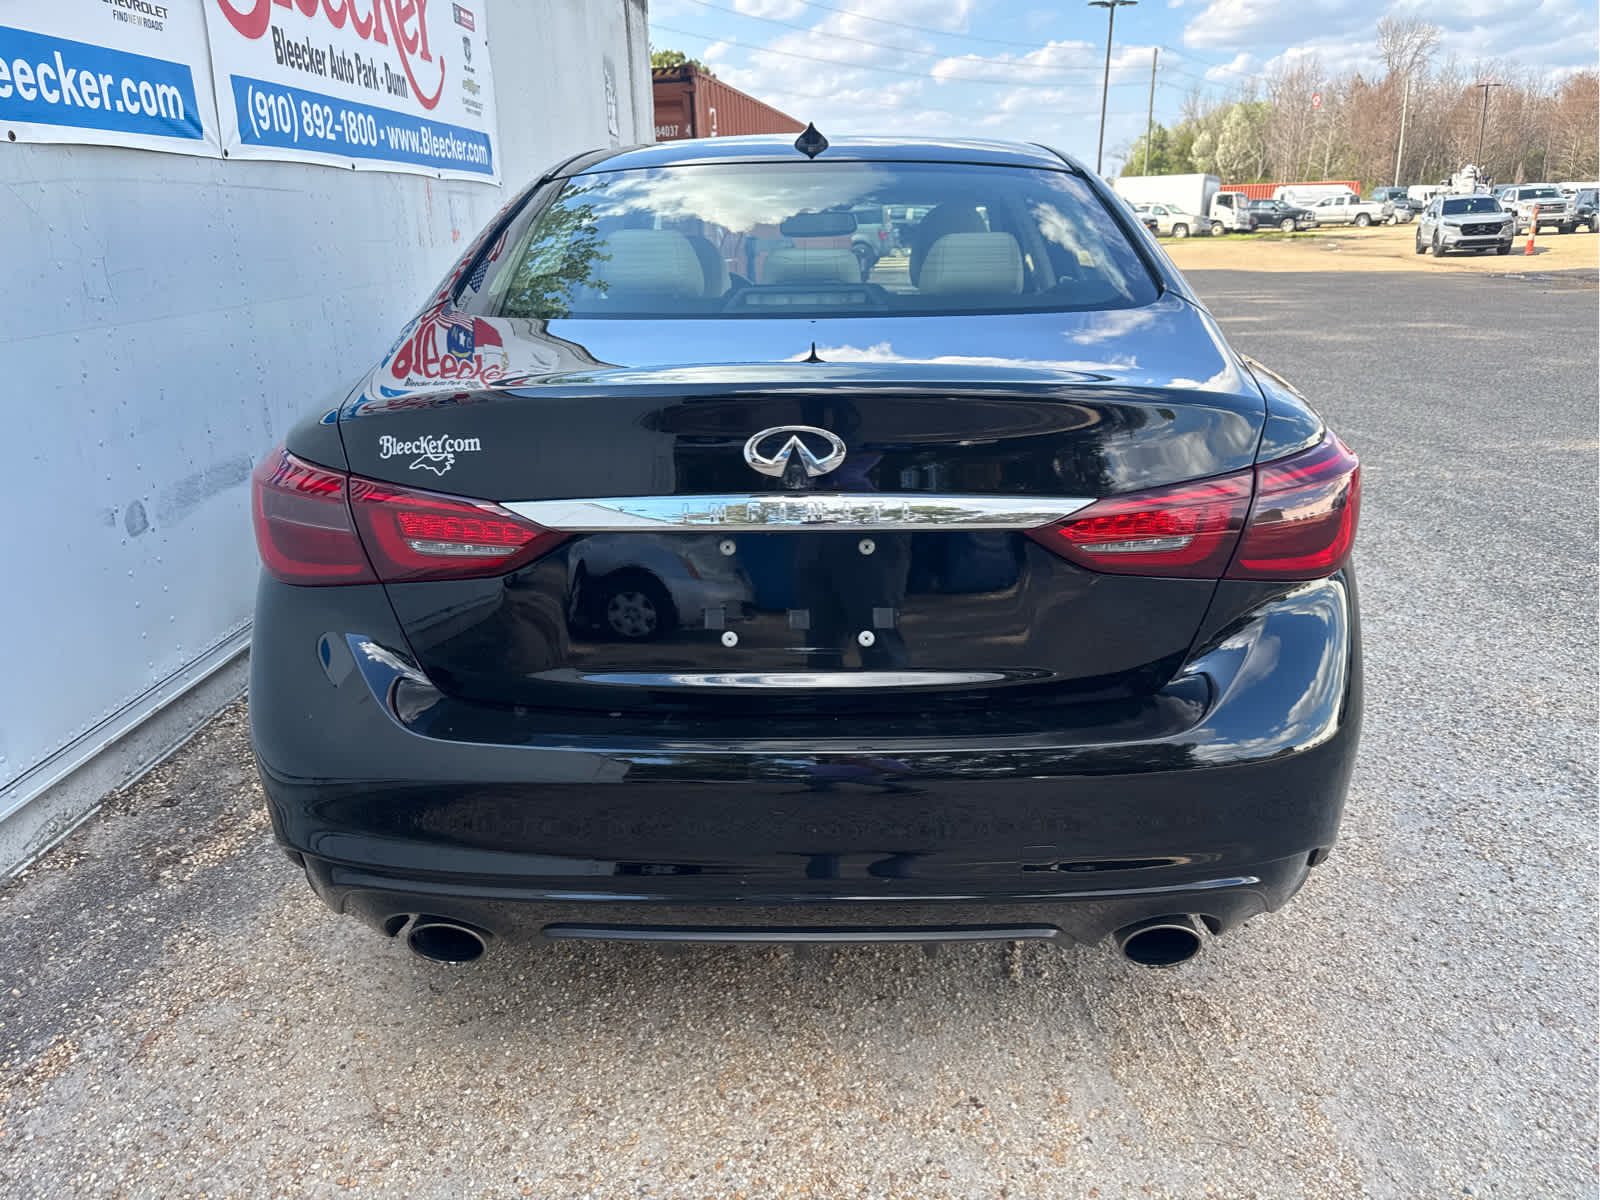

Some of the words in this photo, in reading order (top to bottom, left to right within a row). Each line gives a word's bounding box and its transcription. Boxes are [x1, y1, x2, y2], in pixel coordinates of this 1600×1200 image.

[102, 0, 168, 19] EVROLET
[216, 0, 445, 110] cker
[271, 25, 327, 77] Bleecker
[329, 44, 354, 84] Auto
[354, 52, 380, 91] Park
[384, 62, 409, 99] Dunn
[248, 85, 298, 143] (910)
[302, 101, 377, 147] 892-1800
[387, 125, 488, 165] www.Bleecker.com
